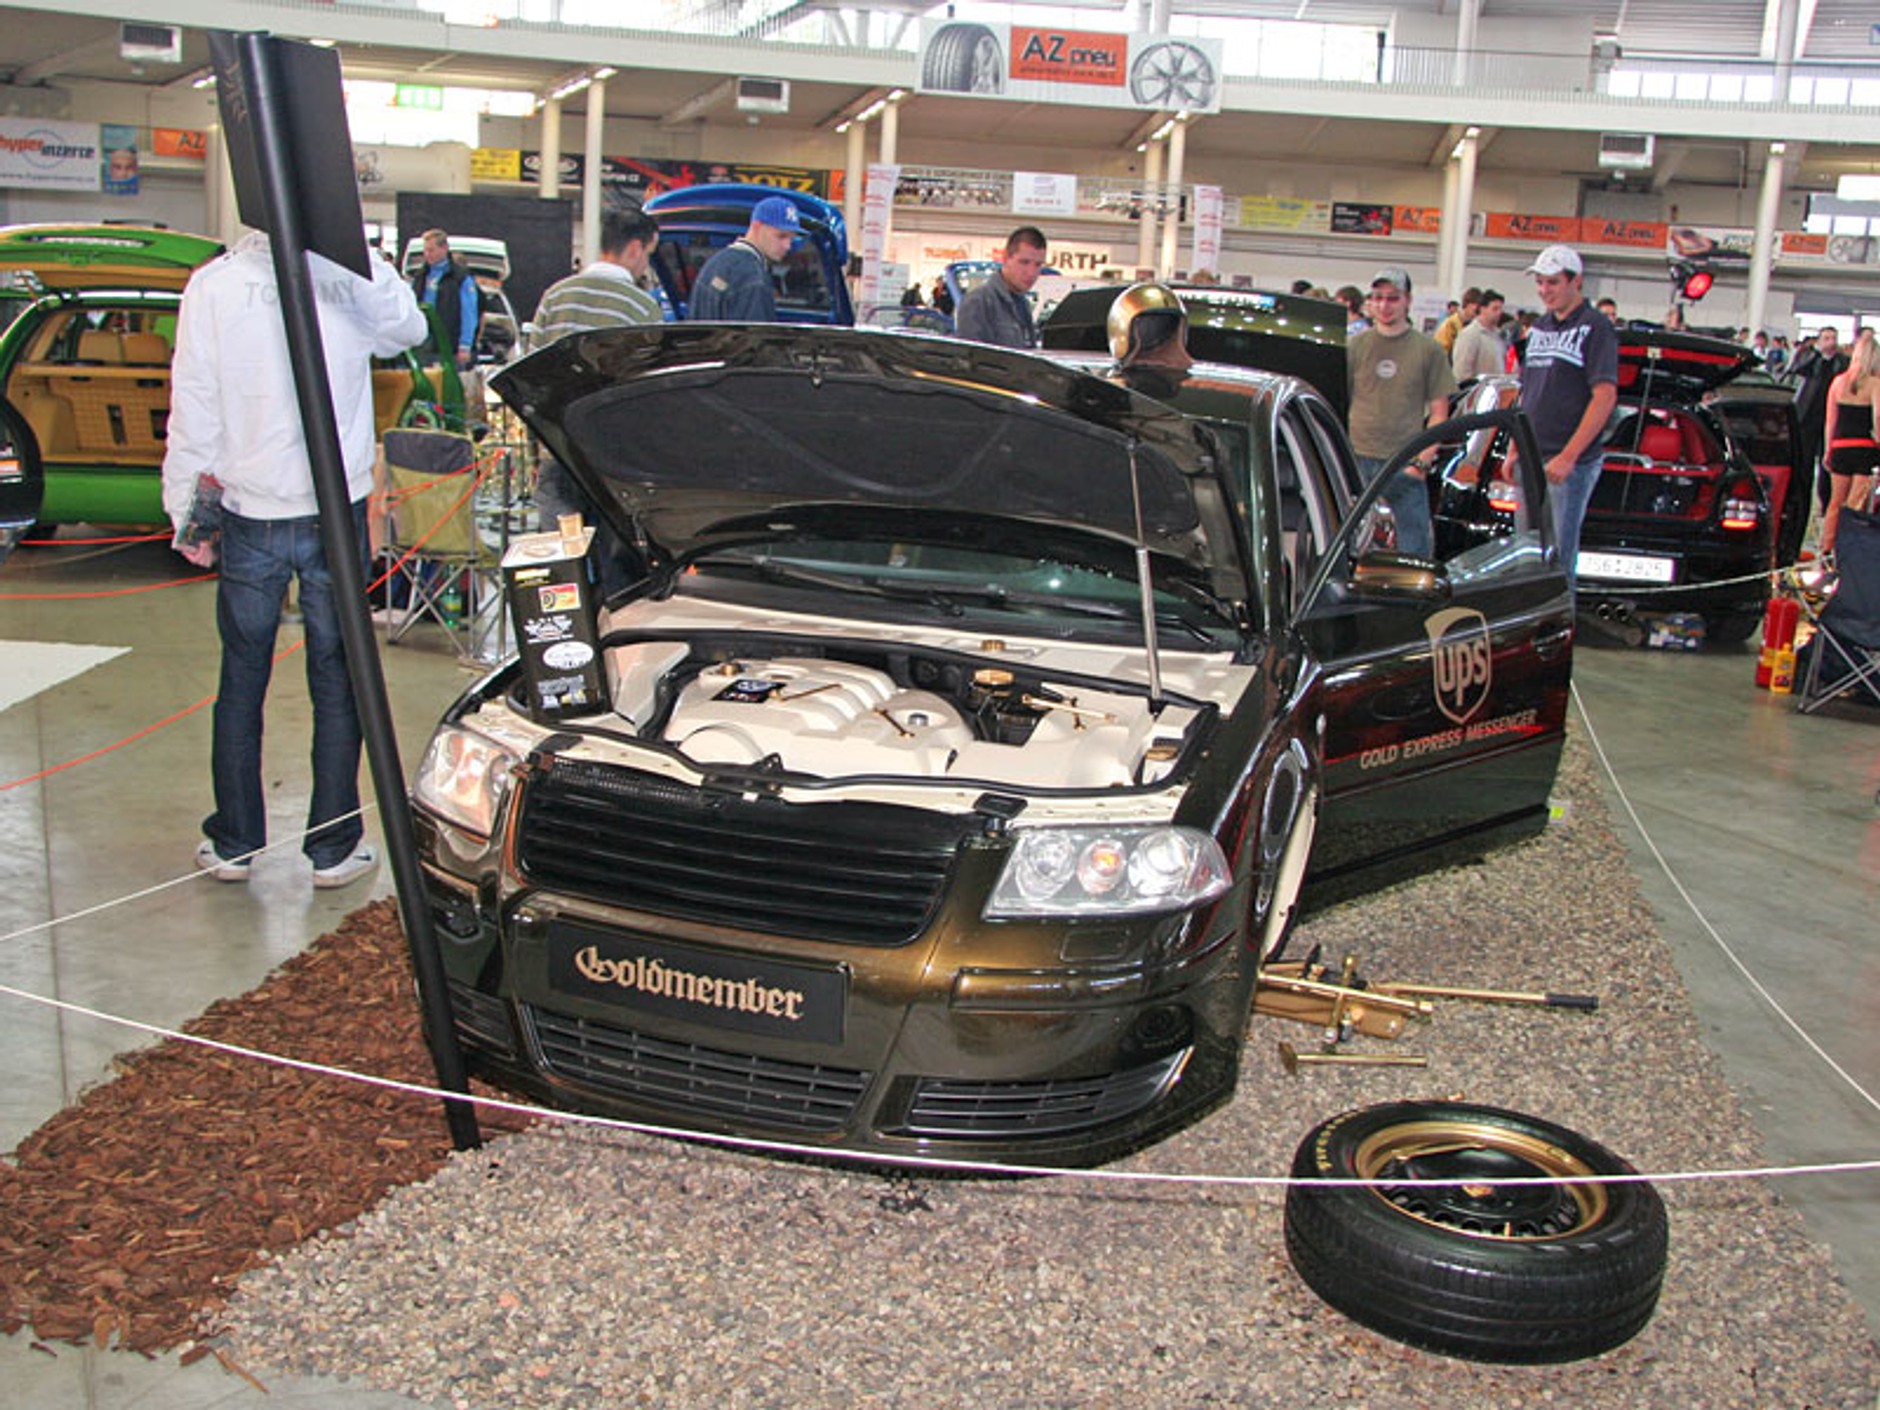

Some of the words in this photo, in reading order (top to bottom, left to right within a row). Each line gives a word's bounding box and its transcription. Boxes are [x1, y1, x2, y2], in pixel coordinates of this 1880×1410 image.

[1022, 34, 1065, 61] AZ
[1070, 48, 1115, 66] pneu
[734, 173, 815, 193] OTZ
[1508, 215, 1531, 231] AZ
[1603, 222, 1627, 236] AZ
[1360, 744, 1398, 770] GOLD
[1402, 728, 1464, 760] EXPRESS
[1466, 708, 1538, 742] MESSENGER
[574, 945, 804, 1021] Goldmember
